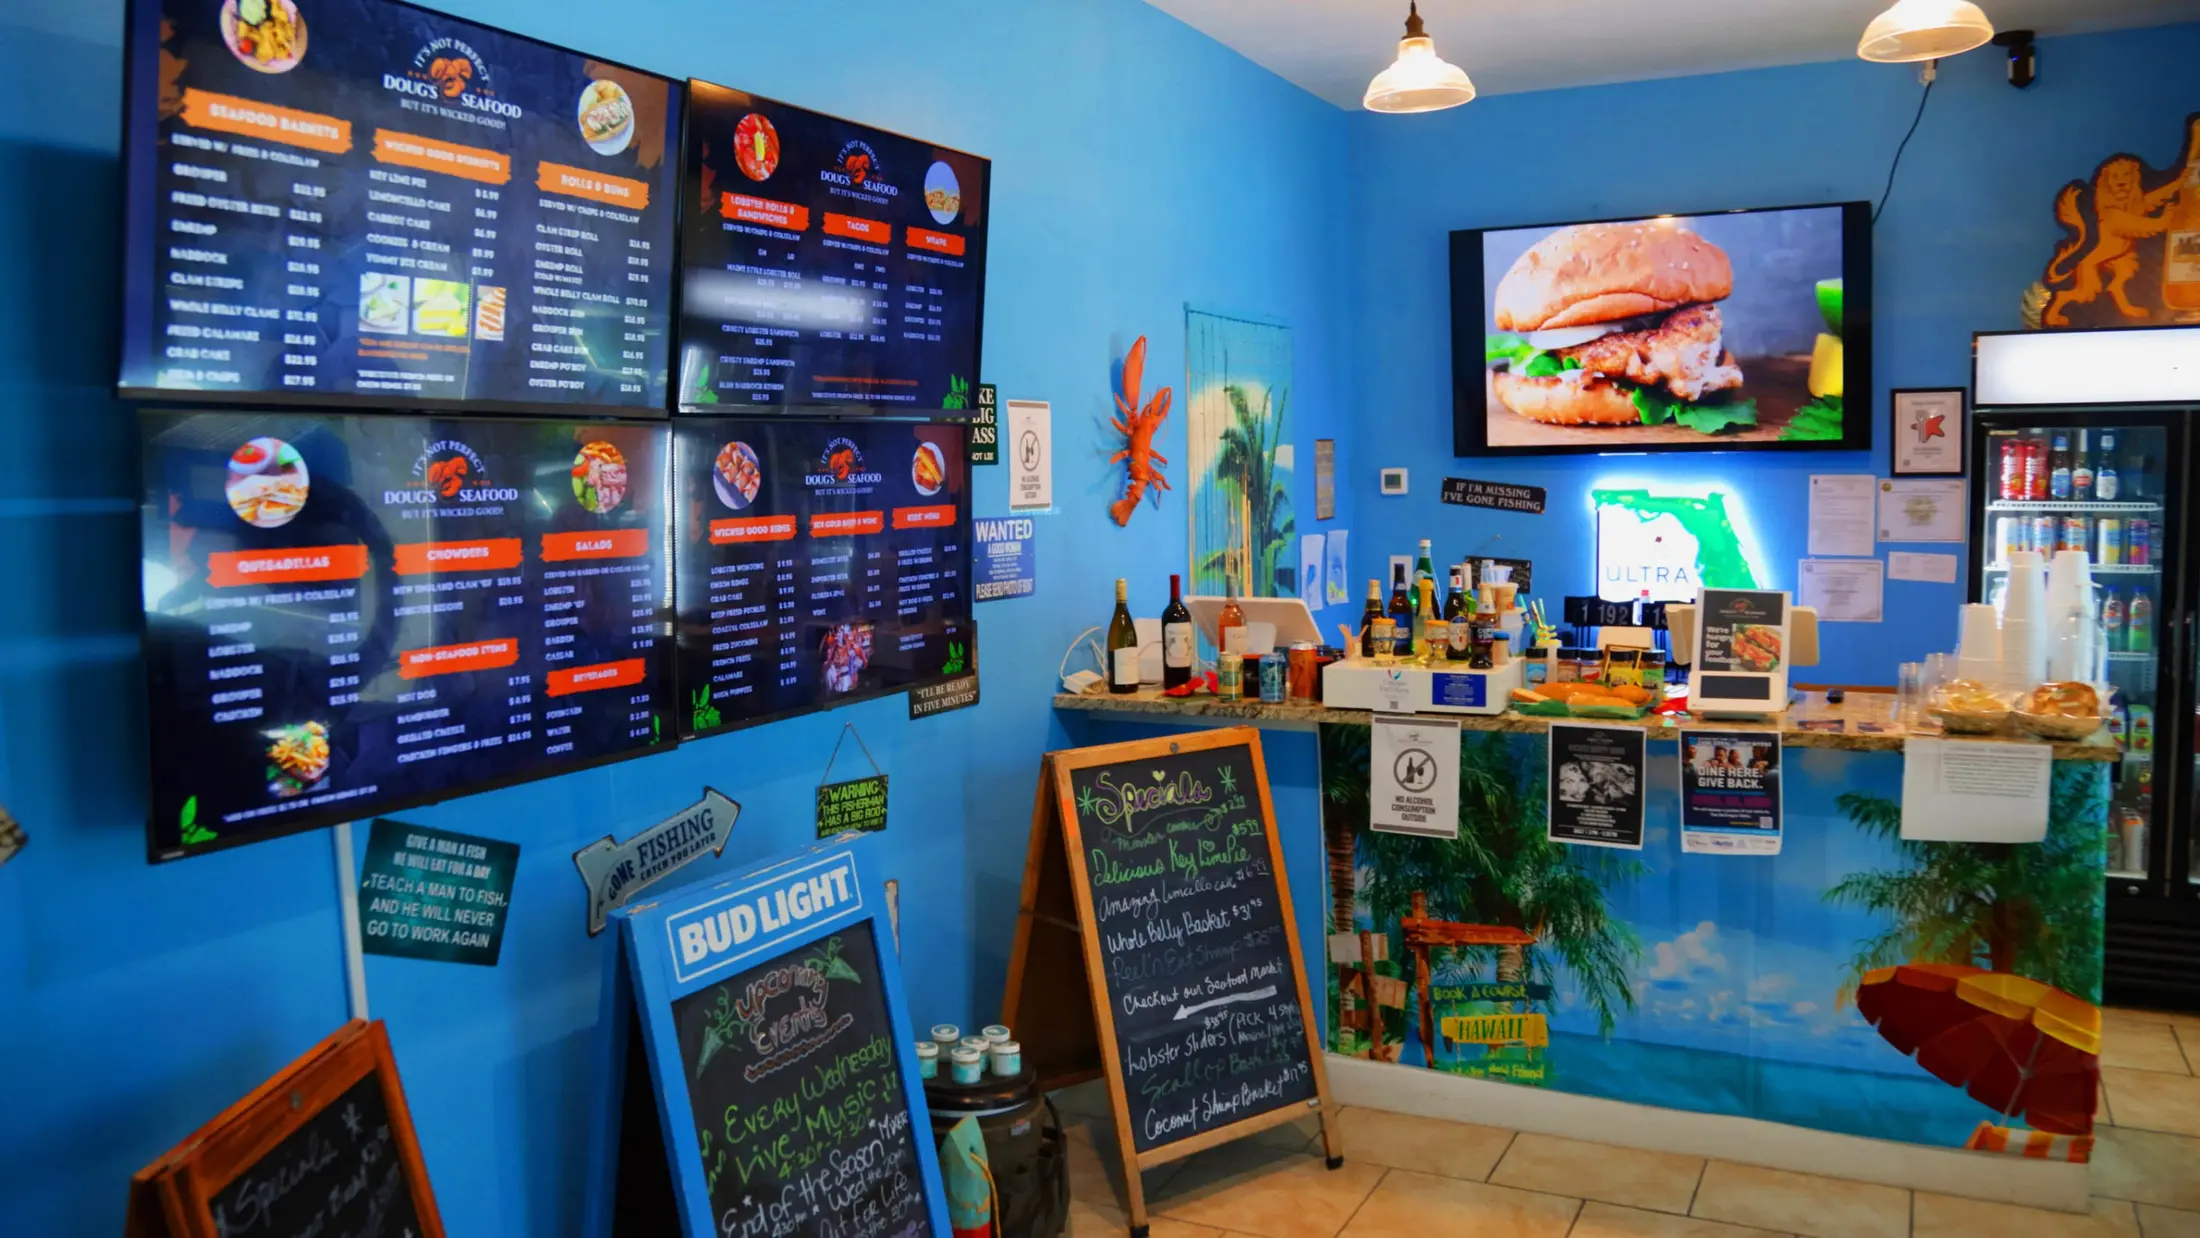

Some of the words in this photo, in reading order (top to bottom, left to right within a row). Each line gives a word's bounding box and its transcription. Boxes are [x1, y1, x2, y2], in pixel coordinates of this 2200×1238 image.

[414, 47, 431, 68] IT'S
[429, 38, 452, 52] NOT
[454, 39, 490, 82] PERFECT
[383, 74, 439, 99] DOUG'S
[461, 93, 522, 119] SEAFOOD
[209, 103, 277, 128] SEAFOOD
[279, 117, 340, 140] BASKETS
[401, 98, 420, 111] BUT
[420, 102, 439, 115] IT'S
[440, 105, 476, 124] WICKED
[477, 115, 506, 130] GOOD!
[384, 140, 425, 156] WICKED
[426, 148, 454, 162] GOOD
[560, 173, 593, 191] ROLLS
[603, 183, 630, 198] BUNS
[820, 170, 851, 186] DOUG'S
[863, 179, 898, 197] SEAFOOD
[737, 207, 788, 226] SANDWICHES
[765, 200, 787, 213] ROLLS
[846, 220, 870, 233] TACOS
[926, 234, 948, 248] WRAPS
[972, 427, 995, 444] ASS
[426, 440, 447, 457] NOT
[448, 440, 486, 474] PERFECT
[806, 474, 835, 486] DOUG'S
[848, 473, 882, 484] SEAFOOD
[384, 490, 437, 505] DOUG'S
[460, 487, 519, 503] SEAFOOD
[1456, 482, 1466, 491] IF
[1468, 483, 1482, 493] I'M
[1485, 486, 1531, 499] MISSING
[1444, 492, 1463, 502] I'VE
[1466, 494, 1495, 505] GONE
[1498, 498, 1541, 510] FISHING
[402, 508, 422, 519] BUT
[424, 507, 438, 518] IT'S
[440, 507, 474, 518] WICKED
[476, 506, 504, 517] GOOD!
[714, 525, 745, 538] WICKED
[746, 524, 768, 535] GOOD
[770, 523, 791, 534] SIDES
[976, 519, 1032, 542] WANTED
[427, 547, 490, 561] CHOWDERS
[575, 540, 613, 552] SALADS
[237, 556, 331, 573] QUESADILLAS
[1606, 566, 1689, 583] ULTRA
[1706, 626, 1729, 634] We're
[573, 668, 618, 683] BEVERAGES
[936, 685, 945, 695] BE
[947, 680, 970, 693] READY
[913, 703, 922, 715] IN
[923, 700, 941, 712] FIVE
[1698, 767, 1725, 778] DINE
[1727, 767, 1764, 779] HERE.
[1698, 777, 1724, 788] GIVE
[1726, 778, 1763, 789] BACK.
[829, 781, 880, 802] WARNING
[1096, 770, 1212, 833] Specials
[1406, 797, 1433, 806] ALCOHOL
[823, 804, 840, 816] THIS
[841, 796, 884, 812] FISHERMAN
[1392, 804, 1436, 814] CONSUMPTION
[825, 814, 841, 827] HAS
[844, 813, 849, 824] A
[851, 810, 864, 822] BIG
[865, 806, 881, 819] ROD
[1402, 813, 1427, 823] OUTSIDE
[406, 833, 428, 849] GIVE
[428, 839, 435, 851] A
[436, 840, 458, 855] MAN
[458, 843, 465, 856] A
[466, 844, 487, 860] FISH
[608, 859, 637, 900] GONE
[636, 808, 715, 868] FISHING
[393, 852, 405, 866] HE
[408, 854, 429, 870] WILL
[431, 857, 447, 871] EAT
[448, 860, 466, 874] FOR
[466, 863, 473, 876] A
[473, 864, 492, 880] DAY
[640, 860, 669, 882] CATCH
[671, 851, 689, 864] YOU
[690, 832, 716, 853] LATER
[1092, 848, 1164, 886] Delicious
[1169, 838, 1198, 881] Key
[370, 874, 413, 893] TEACH
[416, 882, 424, 896] A
[427, 884, 456, 900] MAN
[459, 887, 475, 902] TO
[478, 890, 508, 908] FISH,
[370, 897, 399, 914] AND
[402, 902, 418, 917] HE
[422, 905, 451, 921] WILL
[454, 909, 495, 927] NEVER
[678, 904, 757, 966] BUD
[757, 865, 849, 934] LIGHT
[367, 921, 388, 936] GO
[391, 923, 409, 939] TO
[411, 926, 450, 943] WORK
[451, 931, 490, 948] AGAIN
[1107, 929, 1147, 954] Whole
[1147, 918, 1184, 946] Belly
[1182, 908, 1231, 936] Basket
[1432, 986, 1466, 1000] BOOK
[1471, 986, 1481, 999] A
[1482, 985, 1527, 998] COURSE
[1458, 1018, 1525, 1042] HAWAII
[1126, 1044, 1180, 1076] Lobster
[1145, 1099, 1198, 1141] Coconut
[722, 1204, 768, 1238] End
[799, 1168, 832, 1205] the
[829, 1139, 884, 1186] Season
